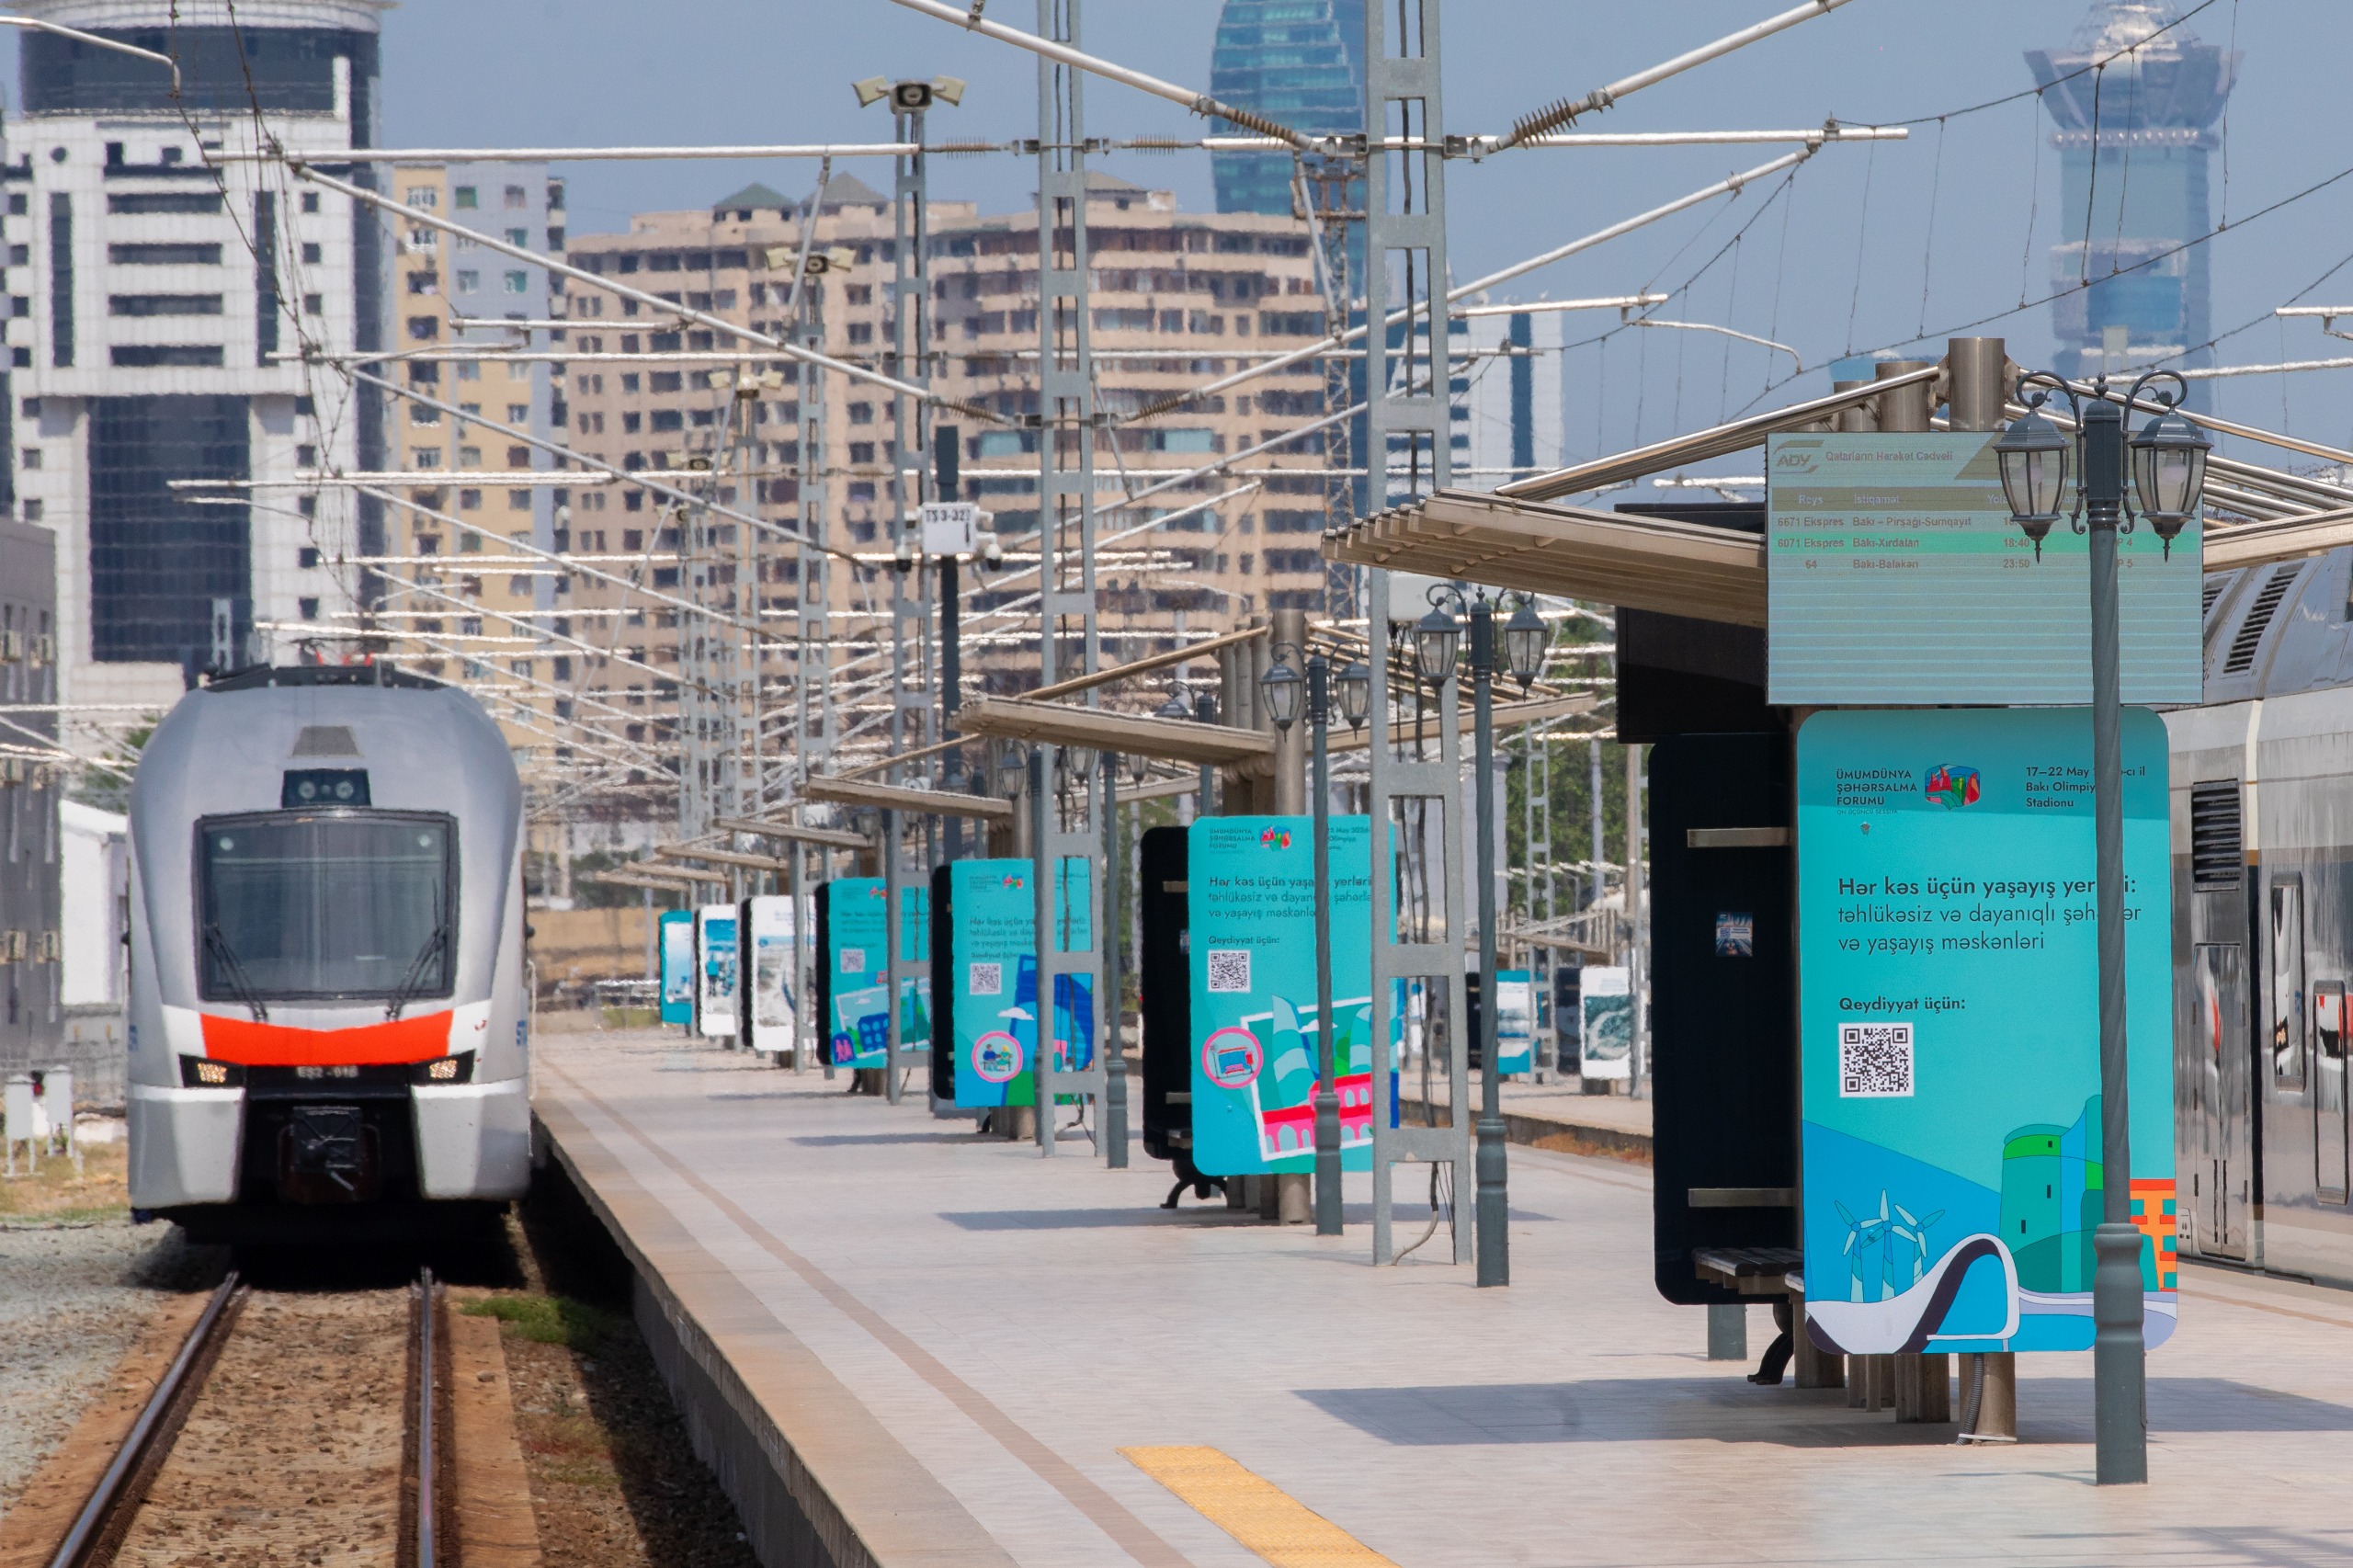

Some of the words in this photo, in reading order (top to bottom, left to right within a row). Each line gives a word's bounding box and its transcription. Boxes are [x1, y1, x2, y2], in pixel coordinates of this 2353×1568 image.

[1776, 454, 1813, 467] ADY
[1798, 494, 1824, 506] Reys
[1778, 517, 1801, 528] 6671
[1803, 517, 1845, 528] Ekspres
[1852, 517, 1875, 527] Bakı
[1778, 538, 1801, 548] 6071
[1803, 538, 1845, 550] Ekspres
[1852, 538, 1920, 548] Bakı-Xırdalan
[2004, 538, 2030, 548] 18:40
[1805, 560, 1818, 569] 64
[2004, 559, 2030, 569] 23:50
[1836, 767, 1912, 779] ÜMUMDÜNYA
[2066, 767, 2089, 778] May
[2139, 766, 2145, 776] il
[1836, 783, 1917, 795] ŞƏHƏRSALMA
[2026, 781, 2049, 791] Bakı
[2052, 781, 2096, 793] Olimpiy
[1836, 796, 1885, 806] FORUMU
[2026, 797, 2074, 808] Stadionu
[1209, 876, 1231, 887] Hər
[1234, 876, 1255, 887] kəs
[1258, 876, 1286, 889] üçün
[1838, 878, 1878, 895] Hər
[1884, 876, 1919, 895] kəs
[1927, 877, 1975, 900] üçün
[1983, 881, 2056, 899] yaşayış
[2063, 874, 2136, 898] yeri:
[1208, 892, 1262, 903] təhlükəsiz
[1265, 893, 1278, 903] və
[1334, 891, 1371, 904] şəhərlə
[1208, 909, 1222, 918] və
[1224, 909, 1263, 920] yaşayış
[1838, 903, 1932, 923] təhlükəsiz
[1939, 909, 1961, 923] və
[1969, 902, 2055, 926] dayanıqlı
[2063, 902, 2142, 926] şəhər
[1208, 936, 1254, 946] Qeydiyyat
[1838, 937, 1860, 951] və
[1868, 937, 1935, 956] yaşayış
[1942, 930, 2045, 950] məskənləri
[1839, 995, 1919, 1014] Qeydiyyat
[1924, 996, 1966, 1014] üçün:
